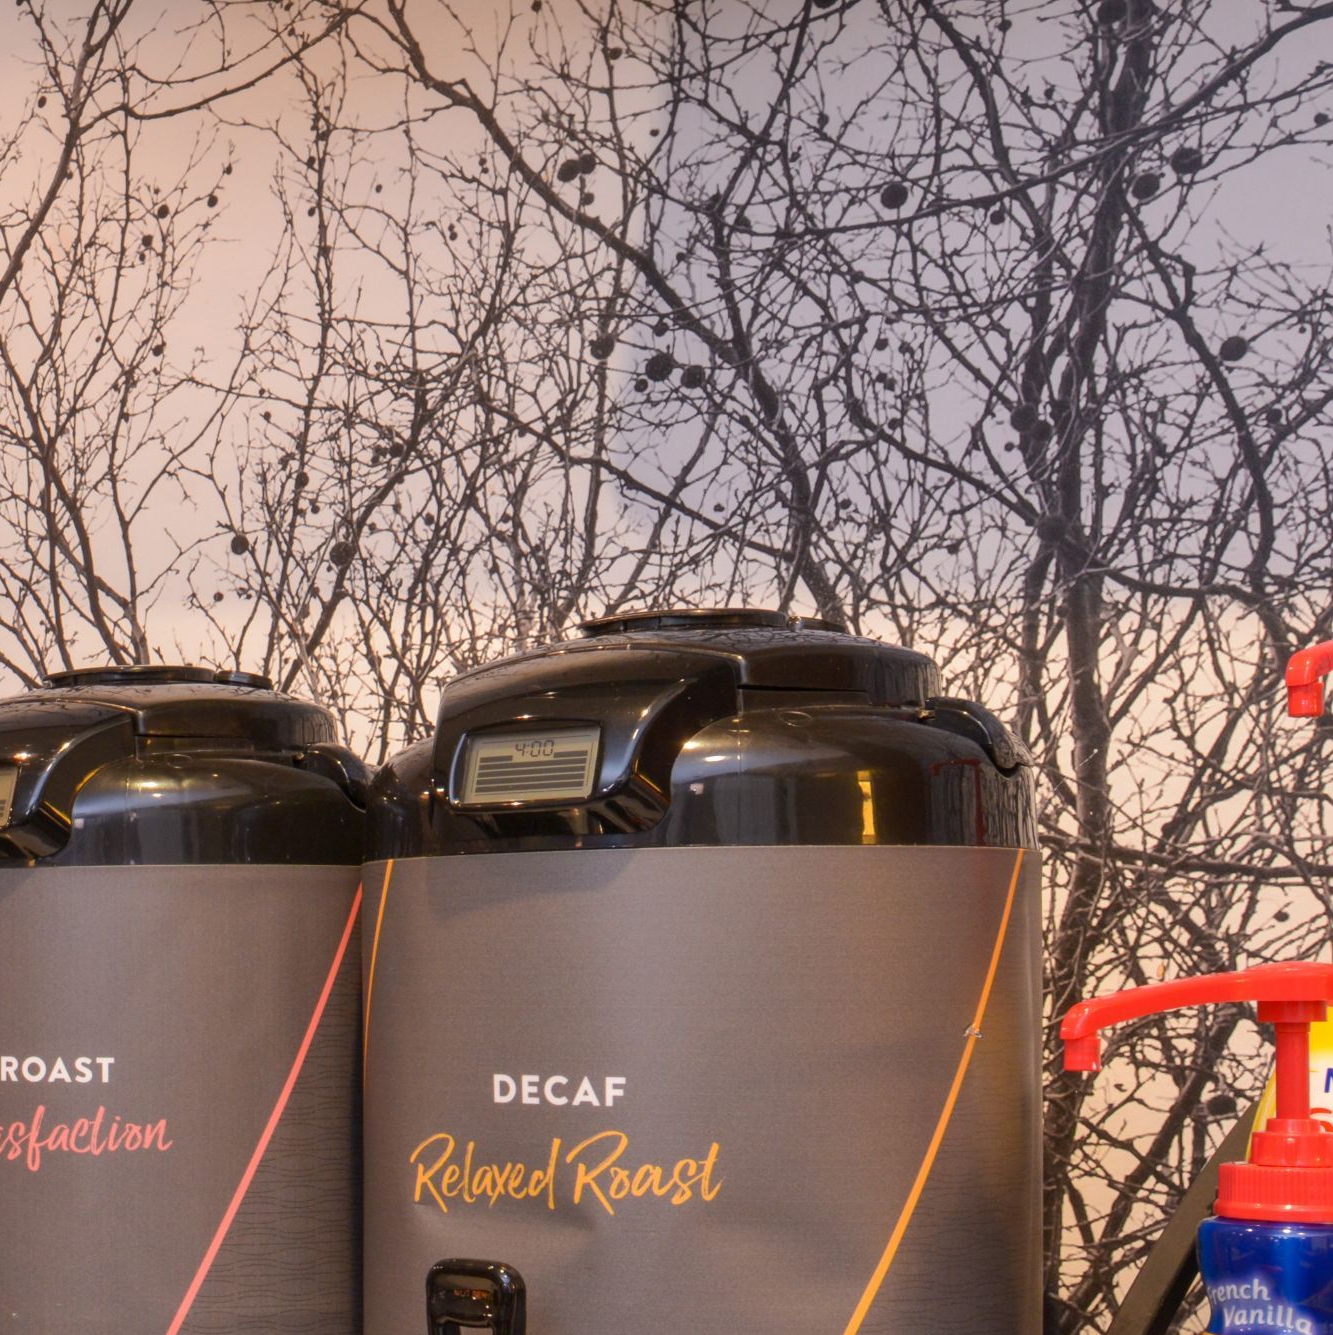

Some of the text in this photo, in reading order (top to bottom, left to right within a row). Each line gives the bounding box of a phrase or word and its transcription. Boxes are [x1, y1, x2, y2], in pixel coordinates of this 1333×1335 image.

[515, 740, 554, 758] 4:00
[0, 1056, 115, 1083] ROAST
[493, 1074, 627, 1107] DECAF
[409, 1130, 725, 1216] Relaxed Roast
